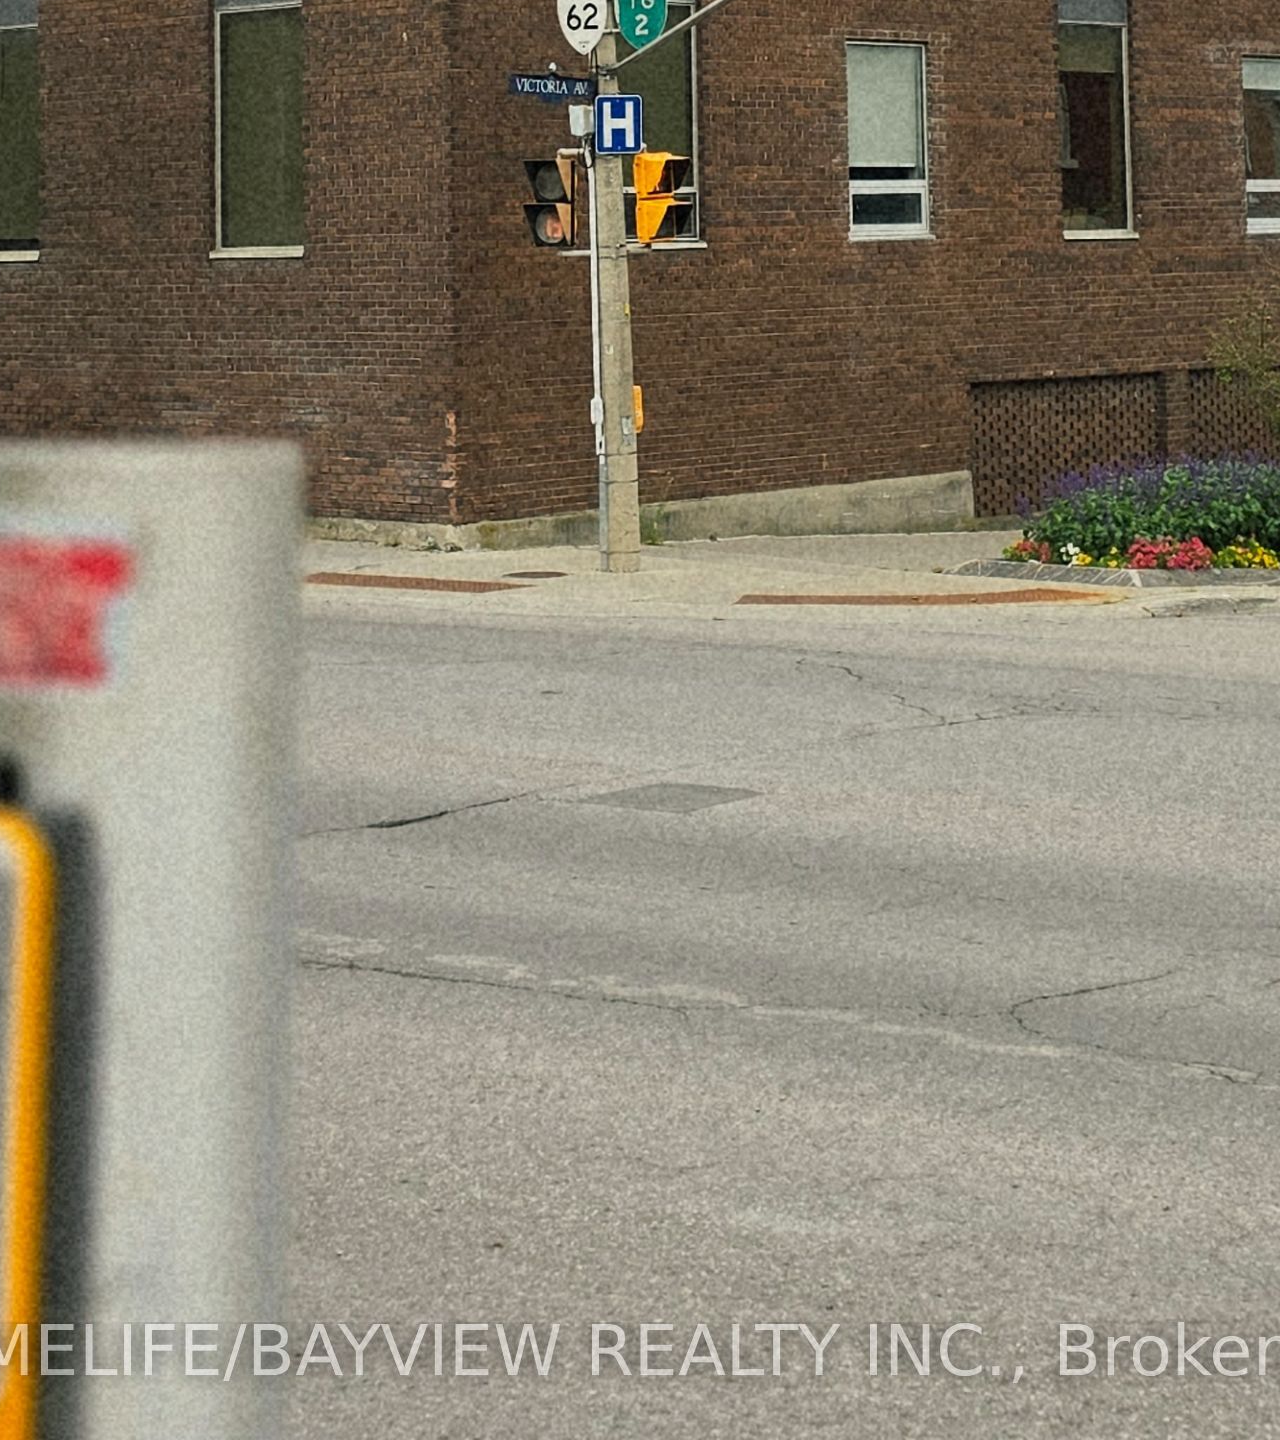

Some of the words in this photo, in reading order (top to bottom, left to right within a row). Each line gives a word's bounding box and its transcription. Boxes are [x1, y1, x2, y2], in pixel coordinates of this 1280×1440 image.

[567, 3, 598, 30] 62
[635, 14, 649, 36] 2
[516, 78, 568, 94] VICTORIA
[602, 101, 635, 148] H
